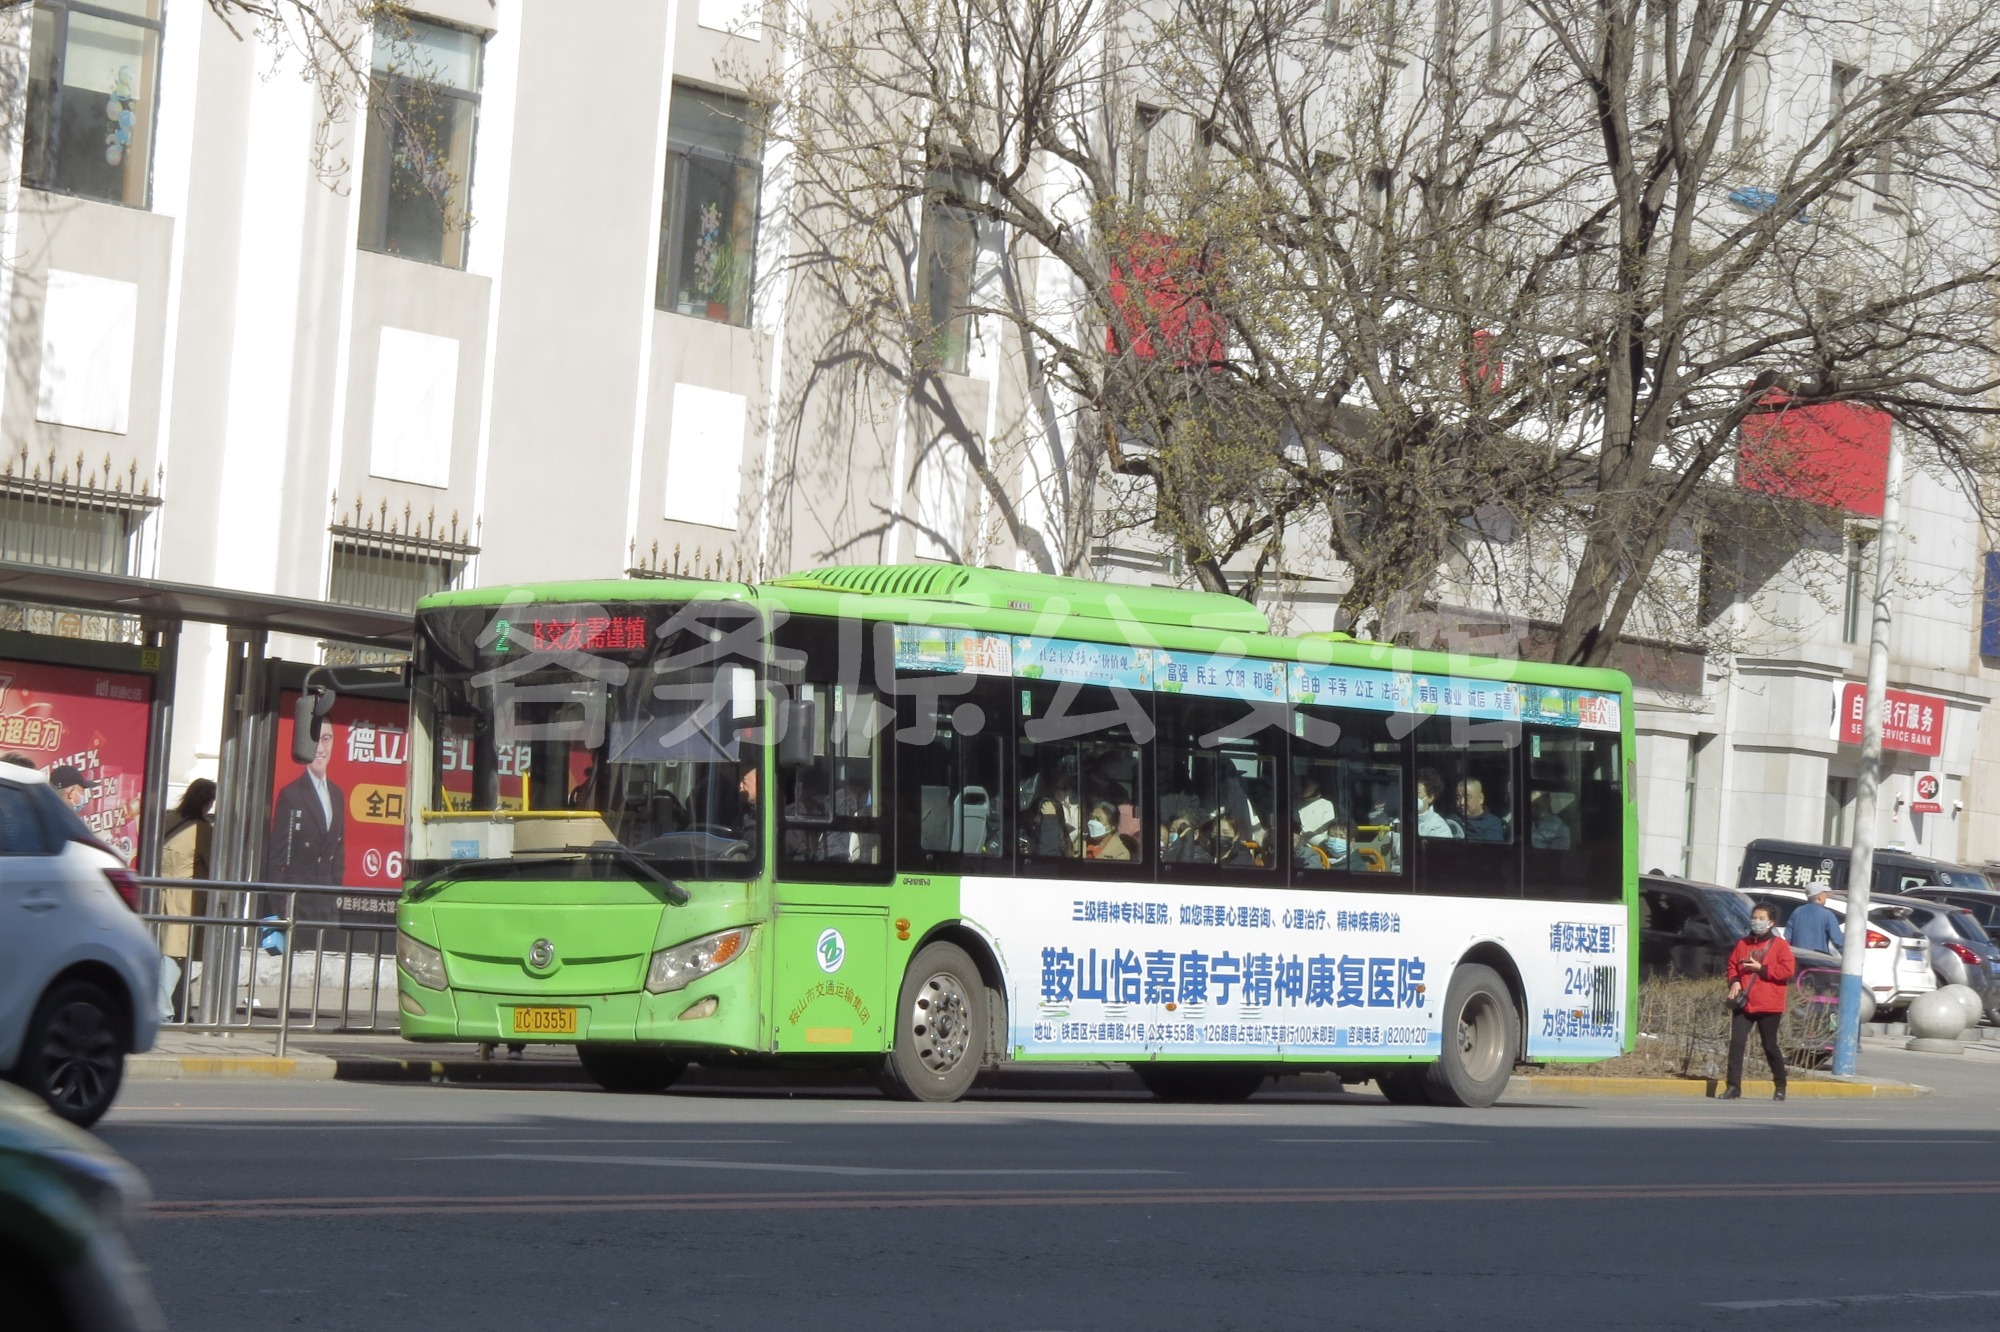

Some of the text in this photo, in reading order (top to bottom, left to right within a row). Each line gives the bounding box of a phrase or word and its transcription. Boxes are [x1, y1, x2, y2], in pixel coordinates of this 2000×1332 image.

[495, 619, 510, 651] 2
[1039, 646, 1129, 671] 社会主义核心价值观
[1167, 663, 1273, 691] 富强 民主 文明 和谐
[1301, 675, 1400, 701] 自由 平等 公正 法治
[1419, 685, 1511, 710] 爱国 敬业 诚信 友善
[1852, 694, 1934, 732] 自银行服务
[347, 719, 408, 765] 德立
[1880, 728, 1909, 742] ERVICE
[1911, 734, 1932, 746] BANK
[1920, 780, 1936, 794] 24
[1755, 862, 1832, 888] 武装押运
[1041, 946, 1426, 1009] 鞍山怡嘉康宁精神康复医院
